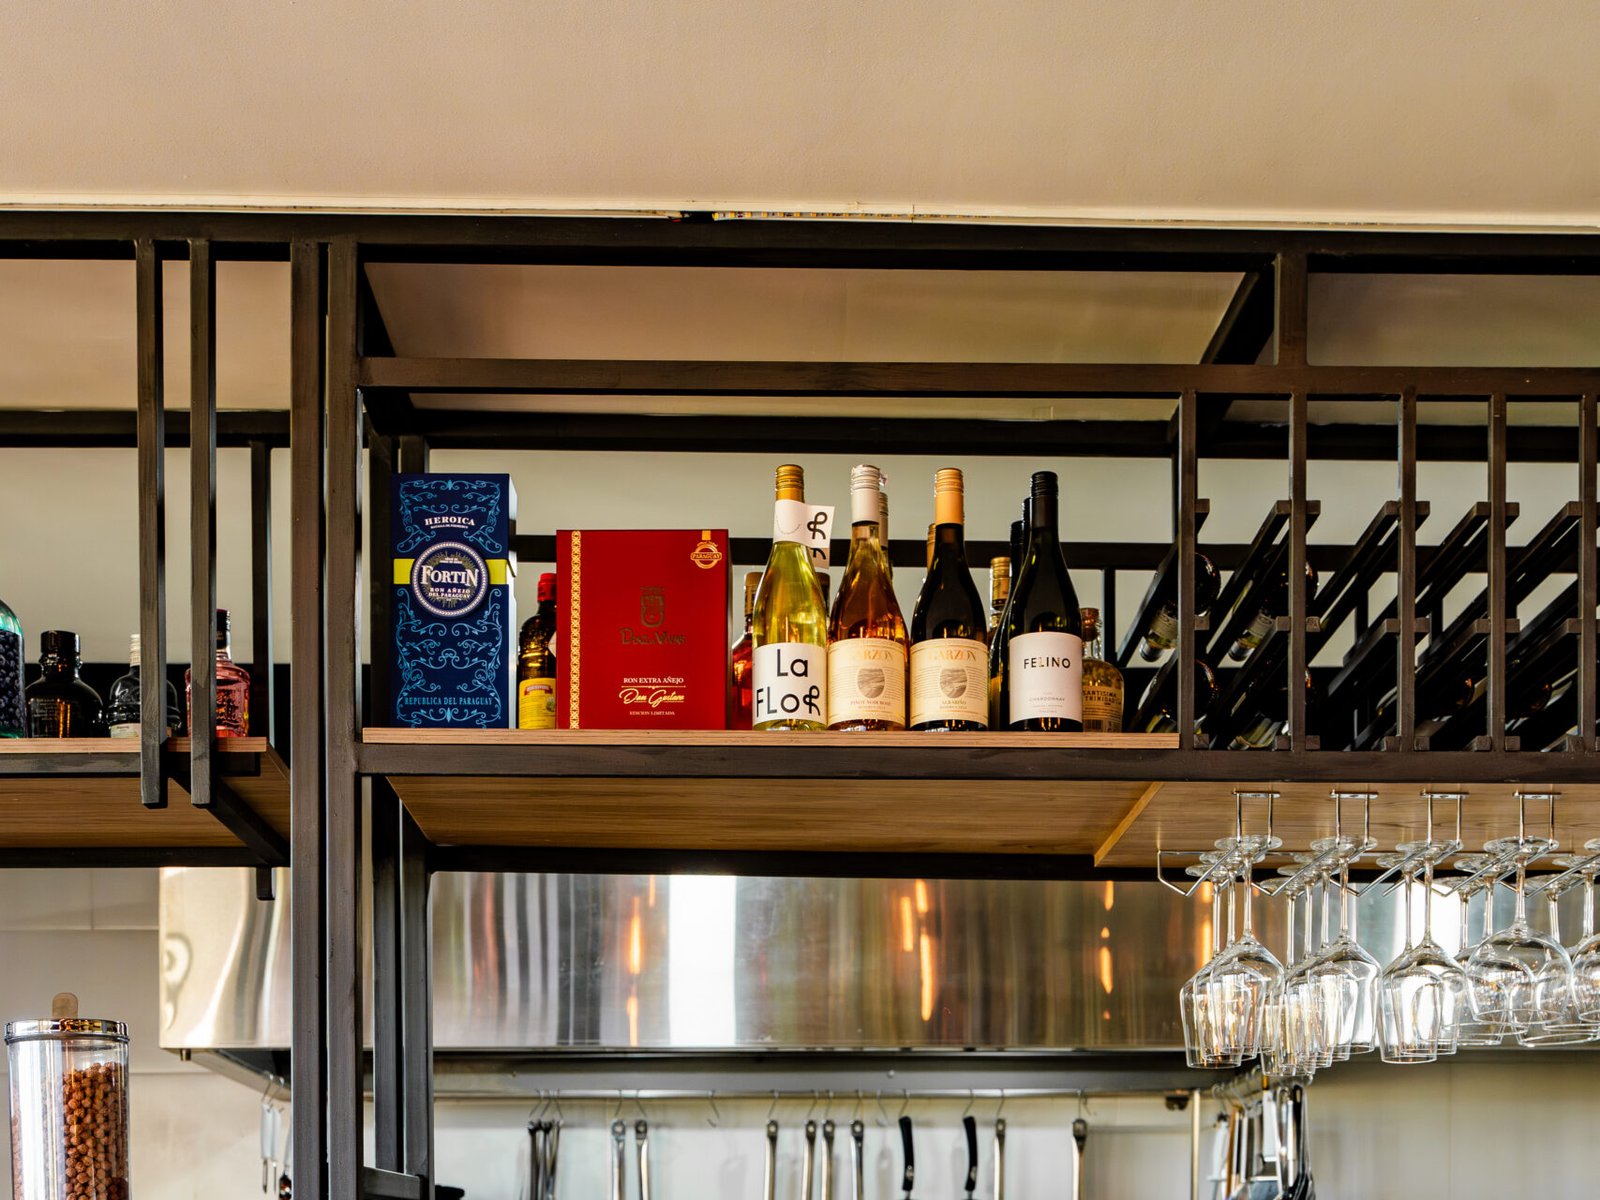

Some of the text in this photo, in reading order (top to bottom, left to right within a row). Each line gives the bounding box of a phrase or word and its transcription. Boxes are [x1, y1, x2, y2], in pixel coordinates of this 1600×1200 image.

[424, 516, 475, 526] HEROICA
[776, 648, 809, 677] La
[1023, 656, 1071, 669] FELINO
[663, 676, 685, 685] AÑEJO
[443, 697, 457, 705] DEL
[459, 697, 493, 705] PARAGUAY
[619, 688, 648, 705] Don
